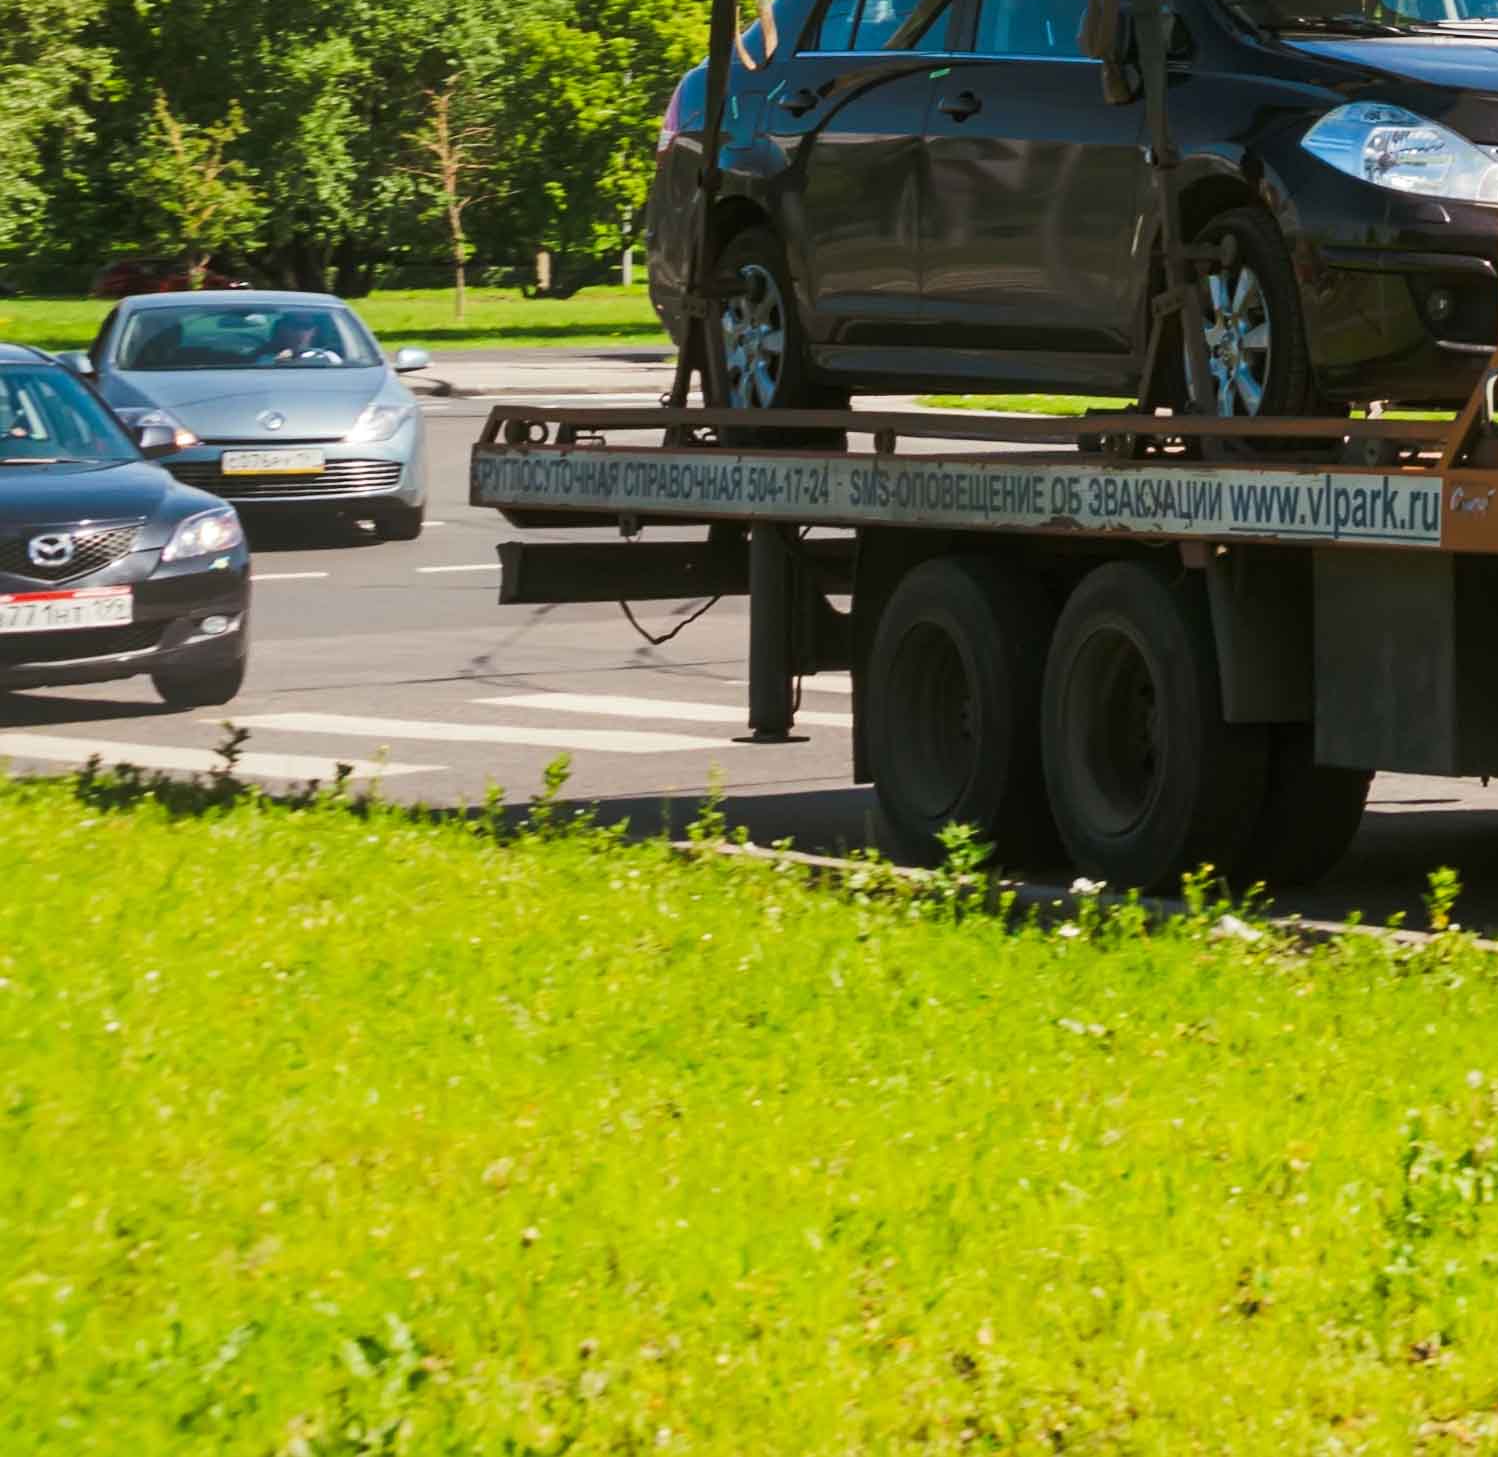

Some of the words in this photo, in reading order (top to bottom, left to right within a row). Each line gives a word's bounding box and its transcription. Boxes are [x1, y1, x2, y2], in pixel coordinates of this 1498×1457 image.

[624, 461, 744, 501] СПРАВОЧНАЯ
[749, 467, 829, 504] 504-17-24
[1051, 476, 1082, 515] ОБ
[1088, 477, 1222, 526] ЭВАКУАЦИИ
